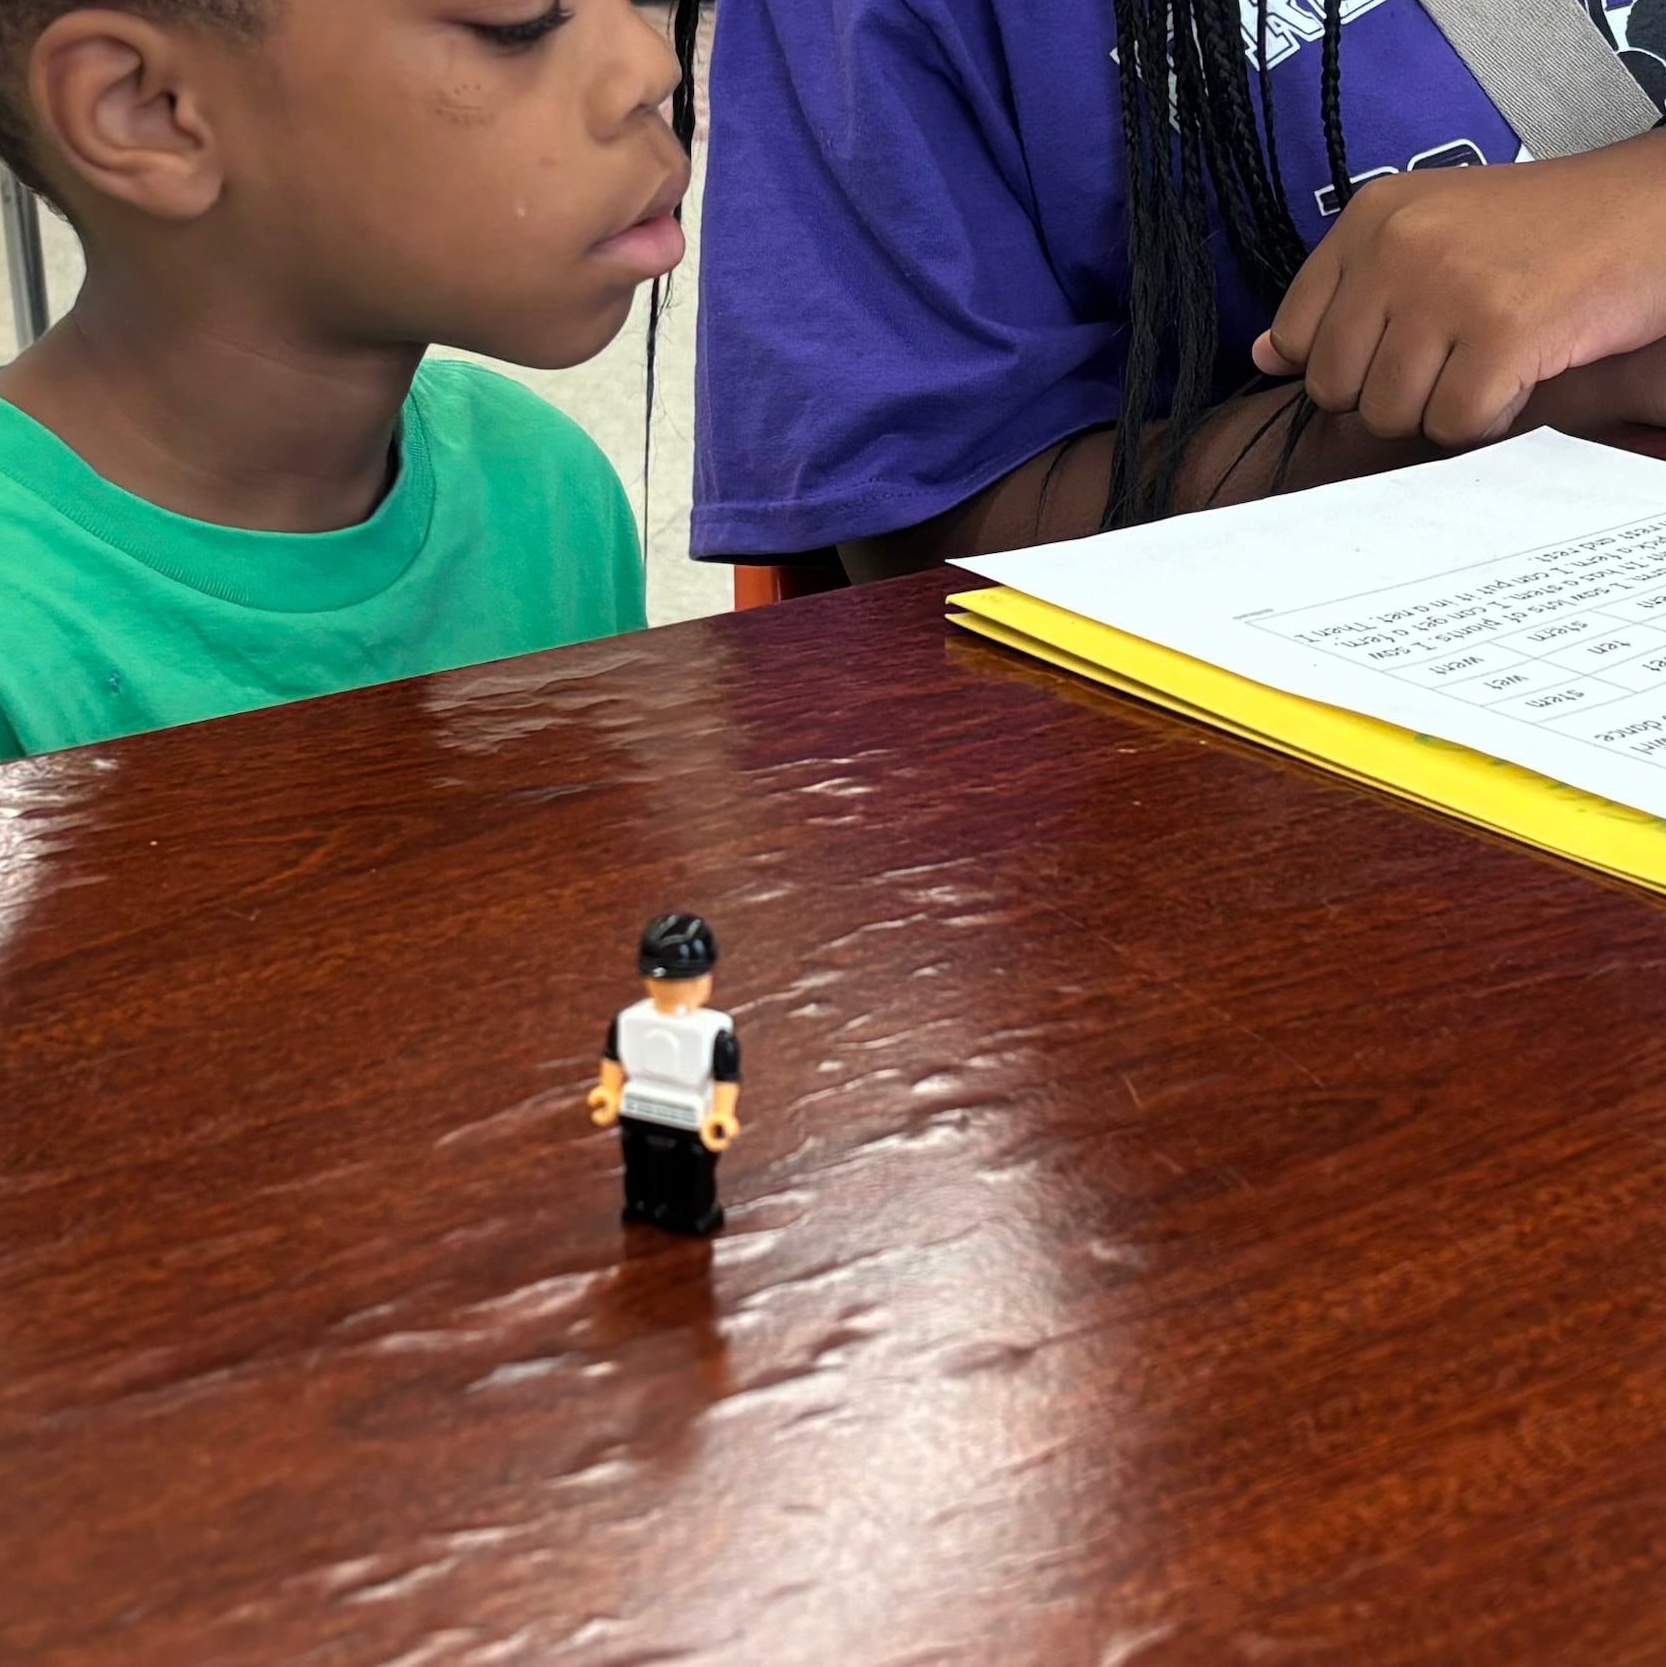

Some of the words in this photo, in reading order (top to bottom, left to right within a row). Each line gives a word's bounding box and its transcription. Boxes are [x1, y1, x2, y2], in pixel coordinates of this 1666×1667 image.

[1617, 525, 1662, 540] rest
[1578, 537, 1617, 551] and
[1528, 547, 1581, 563] rest.
[1565, 552, 1623, 567] fern.
[1549, 567, 1574, 575] I
[1618, 561, 1650, 570] It
[1511, 572, 1550, 584] can
[1578, 568, 1625, 582] has
[1476, 579, 1515, 595] put
[1503, 585, 1564, 600] stem.
[1608, 582, 1634, 590] I
[1454, 593, 1482, 602] it
[1570, 587, 1610, 601] saw
[1412, 605, 1430, 613] a
[1429, 599, 1459, 608] in
[1486, 601, 1512, 609] I
[1527, 599, 1577, 614] lots
[1369, 609, 1415, 623] net.
[1447, 606, 1487, 620] can
[1502, 612, 1528, 623] of
[1411, 616, 1449, 631] get
[1428, 618, 1503, 643] plants.
[1311, 622, 1378, 640] Then
[1391, 629, 1410, 637] a
[1526, 620, 1588, 642] stern
[1294, 634, 1321, 643] I
[1368, 646, 1411, 660] saw
[1410, 641, 1437, 651] I
[1587, 640, 1631, 655] ten
[1428, 656, 1485, 675] went
[1483, 675, 1529, 690] wet
[1524, 689, 1585, 708] stem
[1594, 720, 1663, 742] dance
